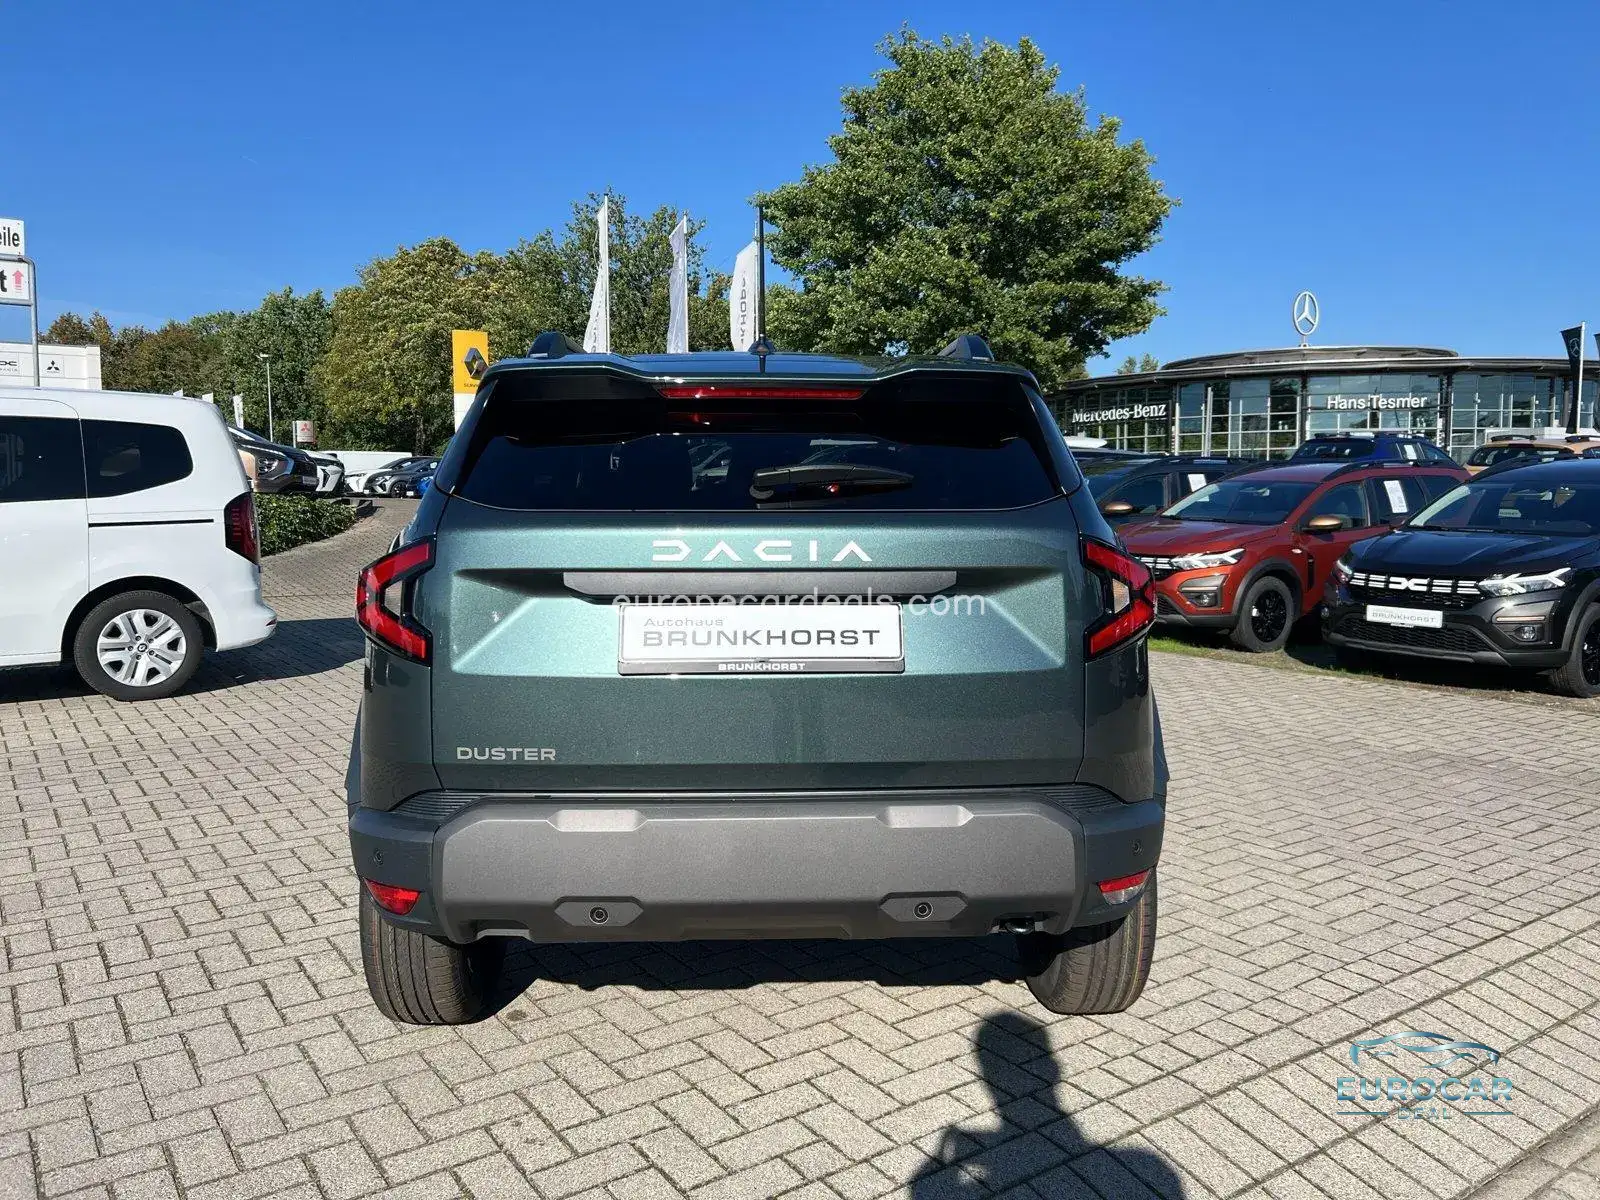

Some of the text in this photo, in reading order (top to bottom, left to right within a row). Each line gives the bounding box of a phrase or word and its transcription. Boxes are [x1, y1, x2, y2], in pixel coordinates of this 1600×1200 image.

[1327, 395, 1428, 410] Hans Tesmer
[1072, 404, 1167, 423] Mercedes-Benz
[652, 540, 873, 562] DACIA
[643, 617, 724, 627] Autohaus
[643, 629, 880, 647] BRUNKHORST
[718, 663, 806, 671] BRUNKHORST
[456, 746, 556, 761] DUSTER
